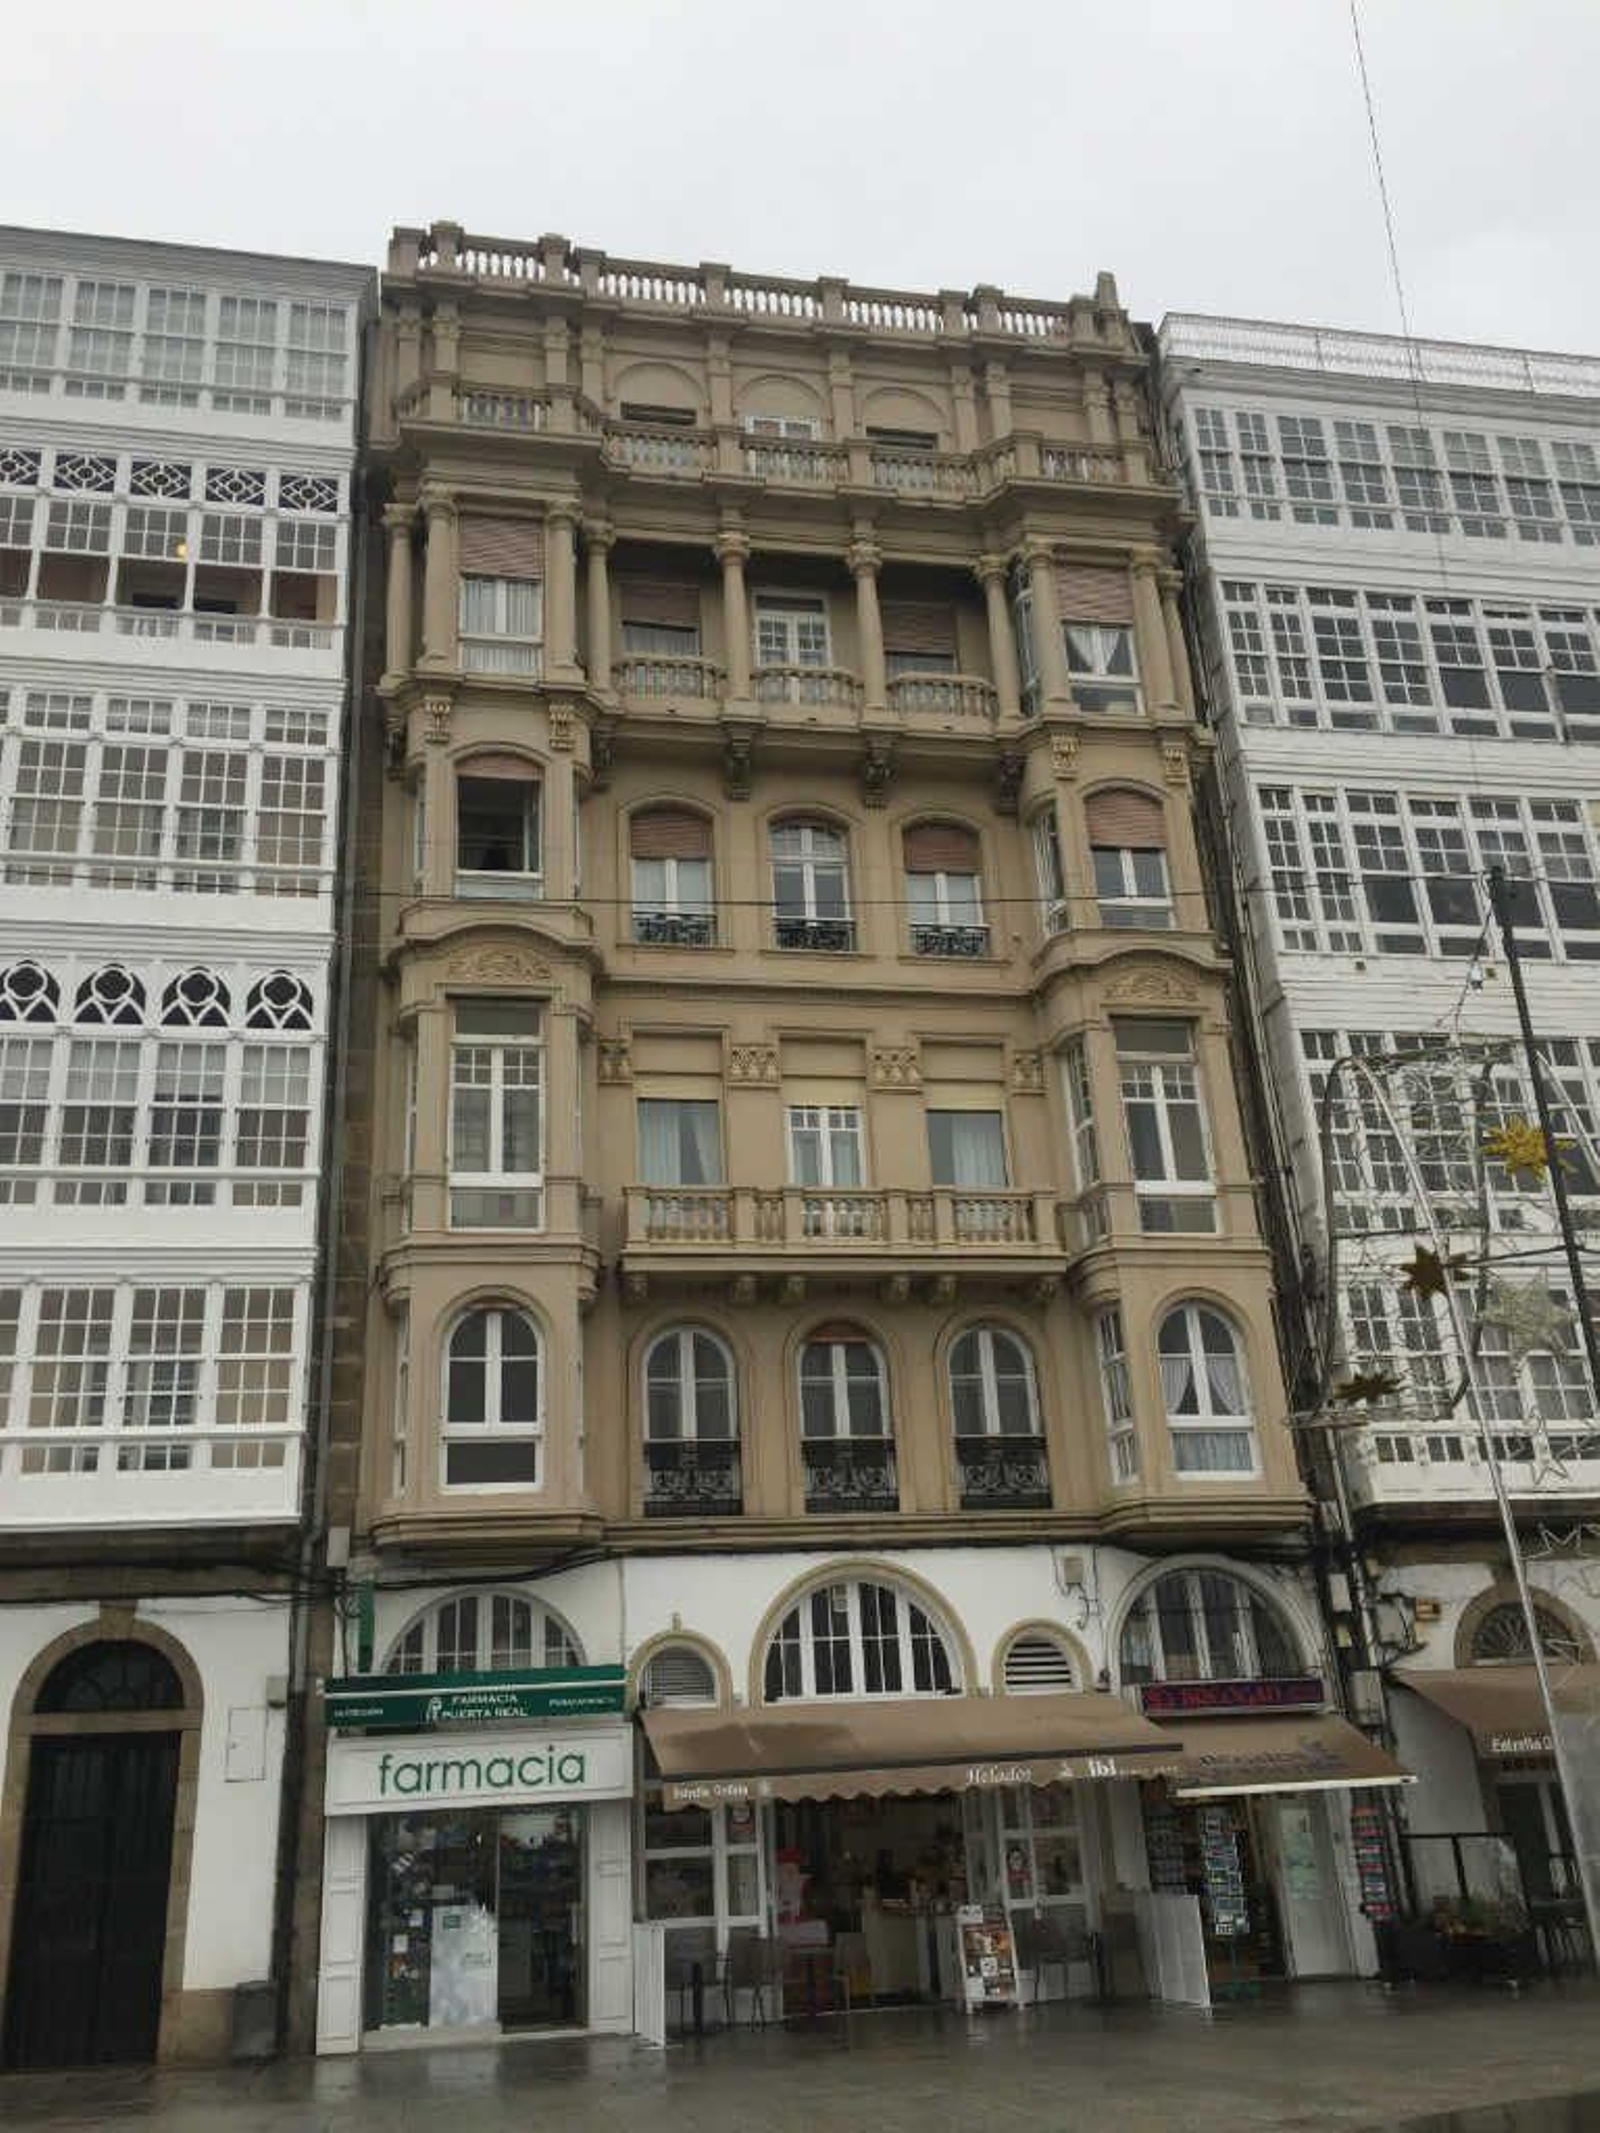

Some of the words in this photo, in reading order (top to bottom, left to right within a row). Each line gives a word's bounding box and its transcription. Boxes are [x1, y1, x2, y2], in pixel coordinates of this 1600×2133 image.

[452, 1694, 519, 1704] FARMACIA
[442, 1708, 493, 1719] PUERTA
[494, 1706, 529, 1717] REAL
[379, 1744, 586, 1796] farmacia
